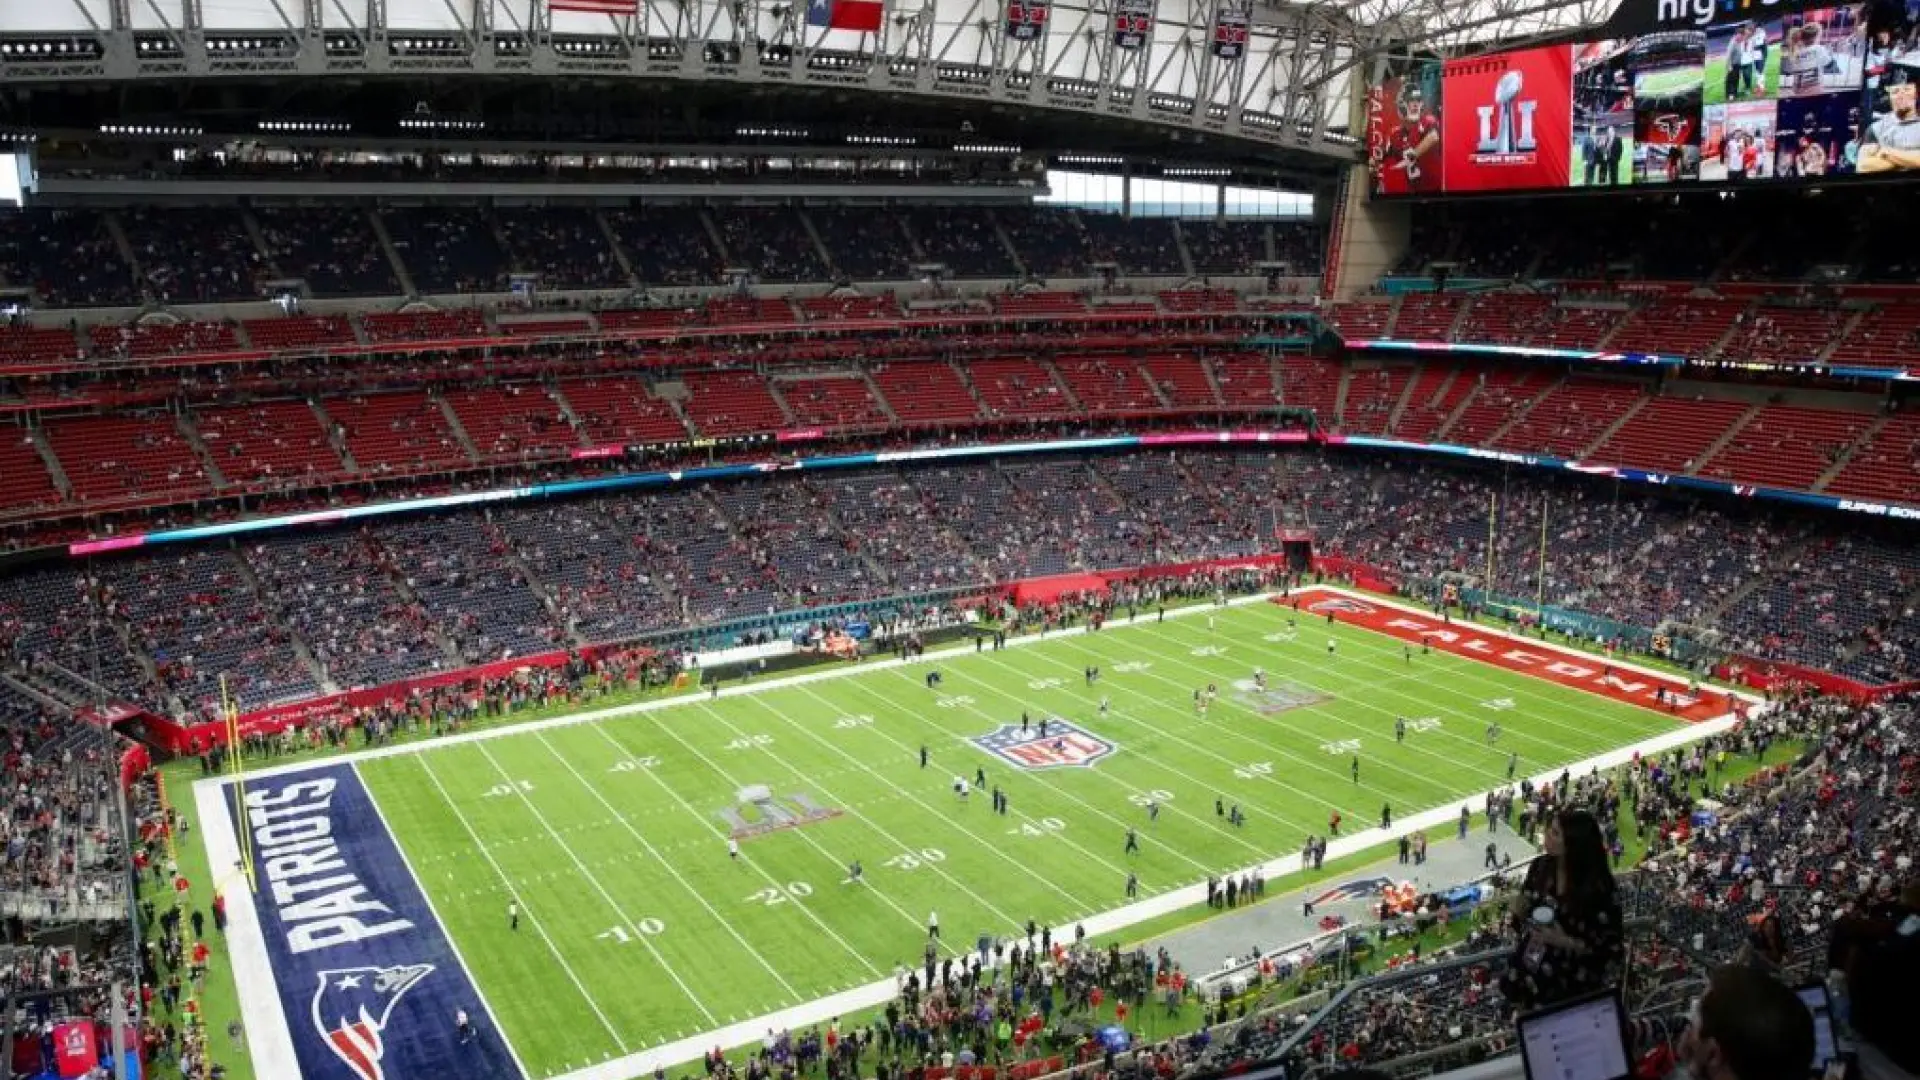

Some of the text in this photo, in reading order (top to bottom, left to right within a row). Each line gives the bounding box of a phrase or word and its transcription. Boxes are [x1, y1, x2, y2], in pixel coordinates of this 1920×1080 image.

[1837, 500, 1886, 515] SUPER
[1004, 732, 1109, 766] NFL
[1021, 817, 1067, 836] 40
[247, 777, 416, 954] PATRIOTS
[899, 848, 946, 870] 30
[762, 881, 813, 906] 20
[610, 917, 665, 943] 10
